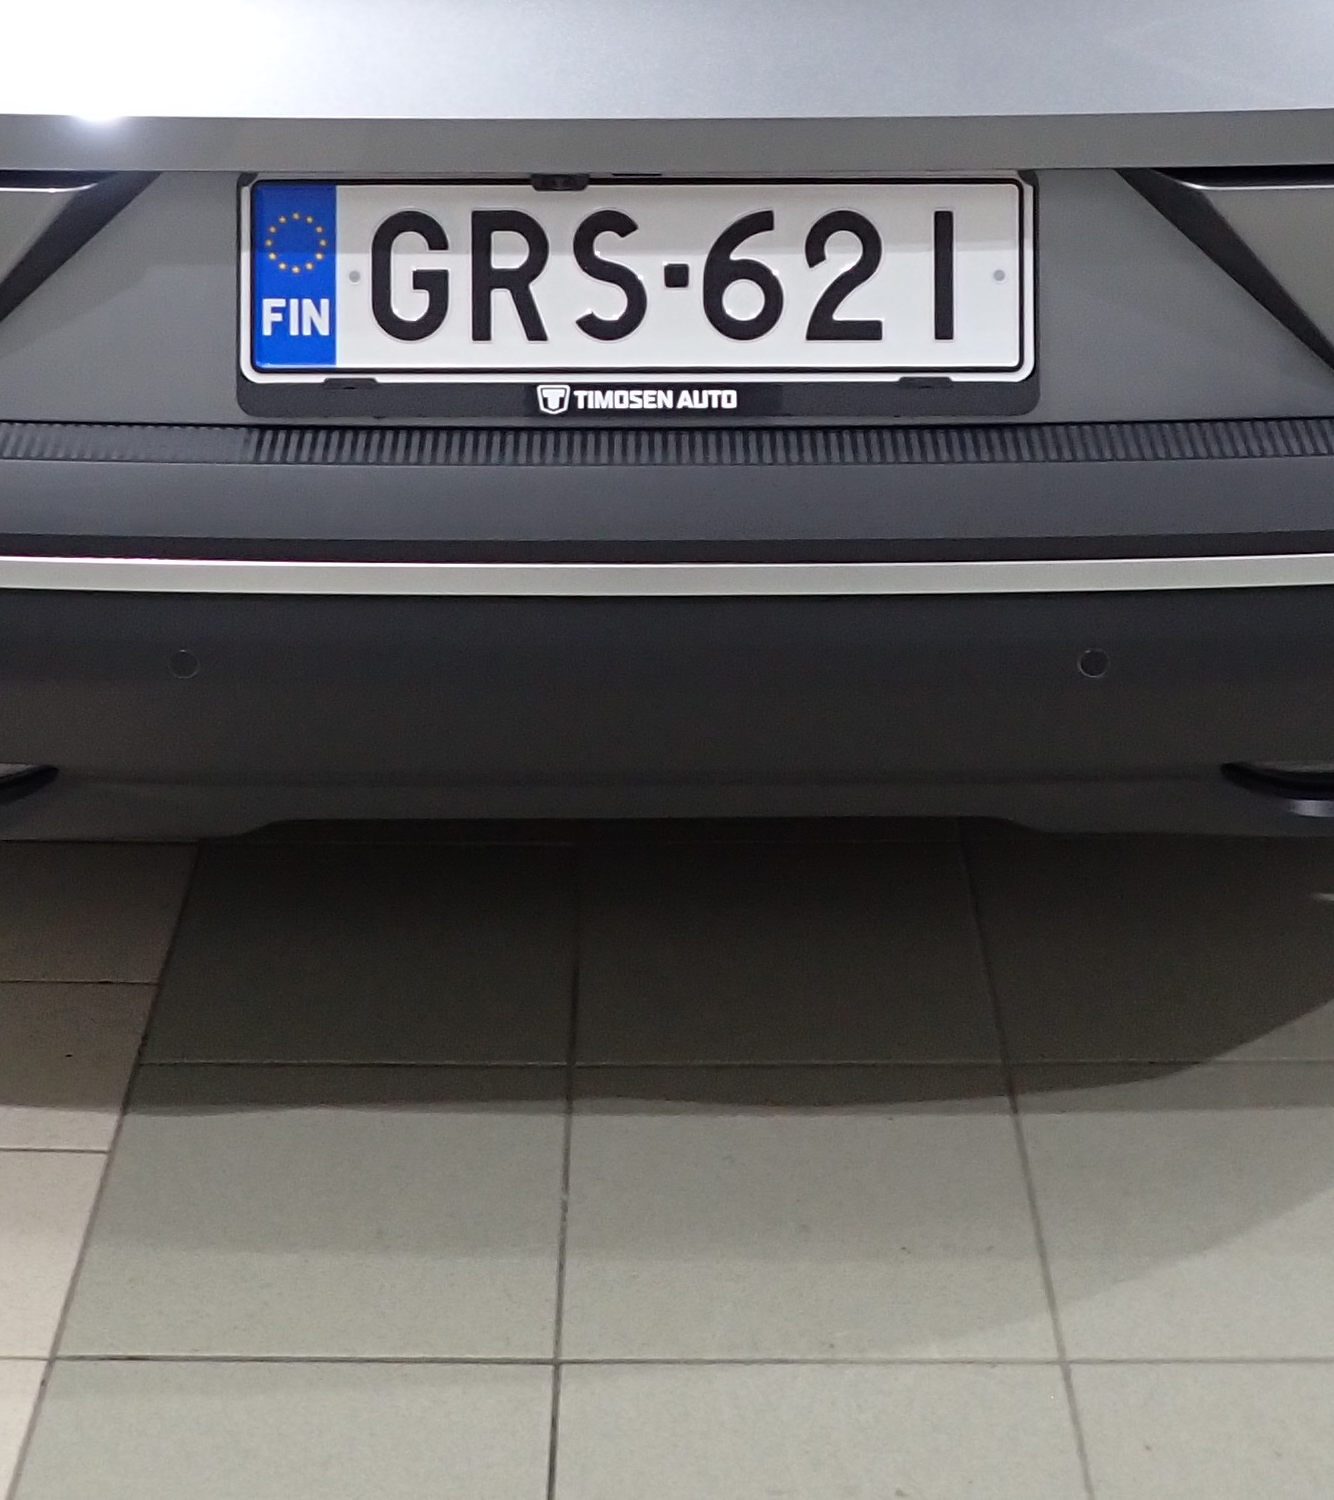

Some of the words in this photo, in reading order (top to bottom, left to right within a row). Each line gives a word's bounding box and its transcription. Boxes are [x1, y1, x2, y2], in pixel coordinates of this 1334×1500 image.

[371, 209, 954, 342] GRS-621
[262, 298, 330, 336] FIN
[573, 389, 674, 409] TIMOSEN
[676, 389, 738, 409] AUTO
